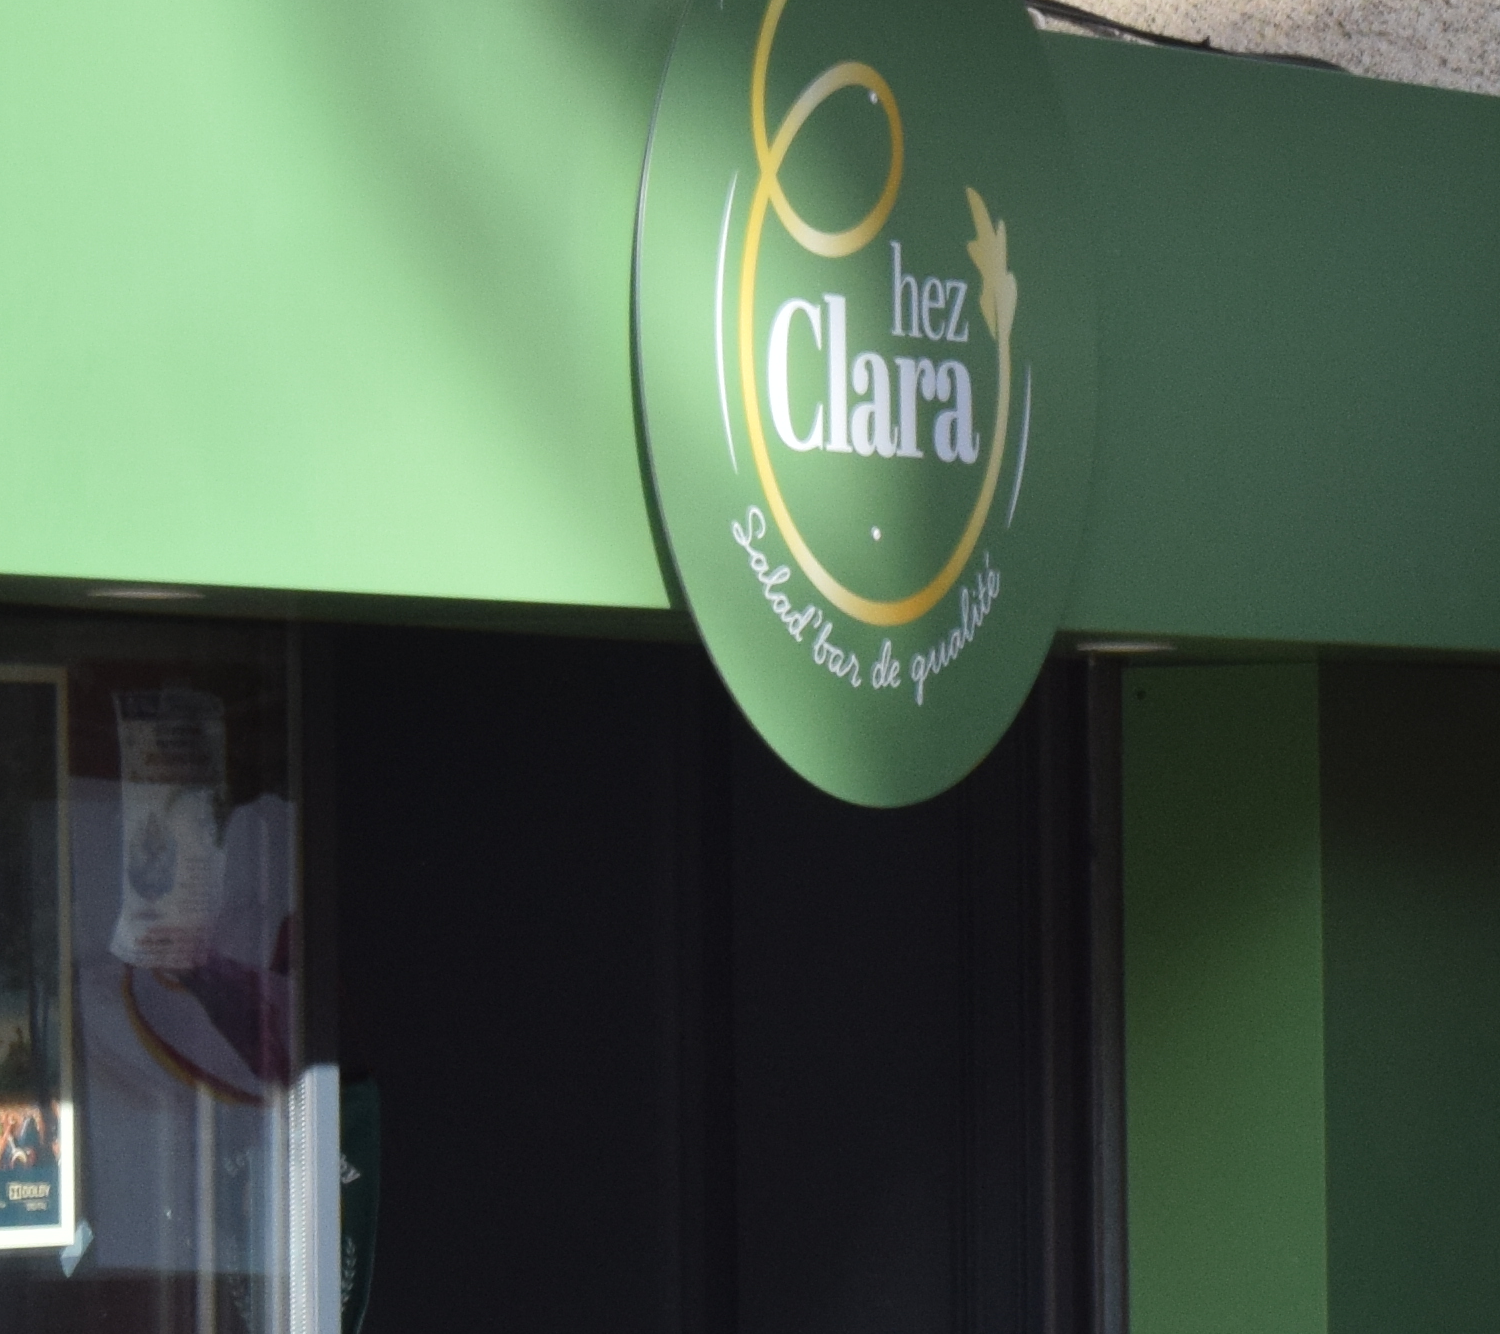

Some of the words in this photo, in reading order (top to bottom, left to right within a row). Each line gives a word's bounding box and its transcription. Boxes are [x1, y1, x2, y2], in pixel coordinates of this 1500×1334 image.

[766, 292, 980, 465] Clara
[731, 505, 861, 688] Salad'bar
[871, 638, 901, 689] de
[911, 551, 1000, 706] qualité
